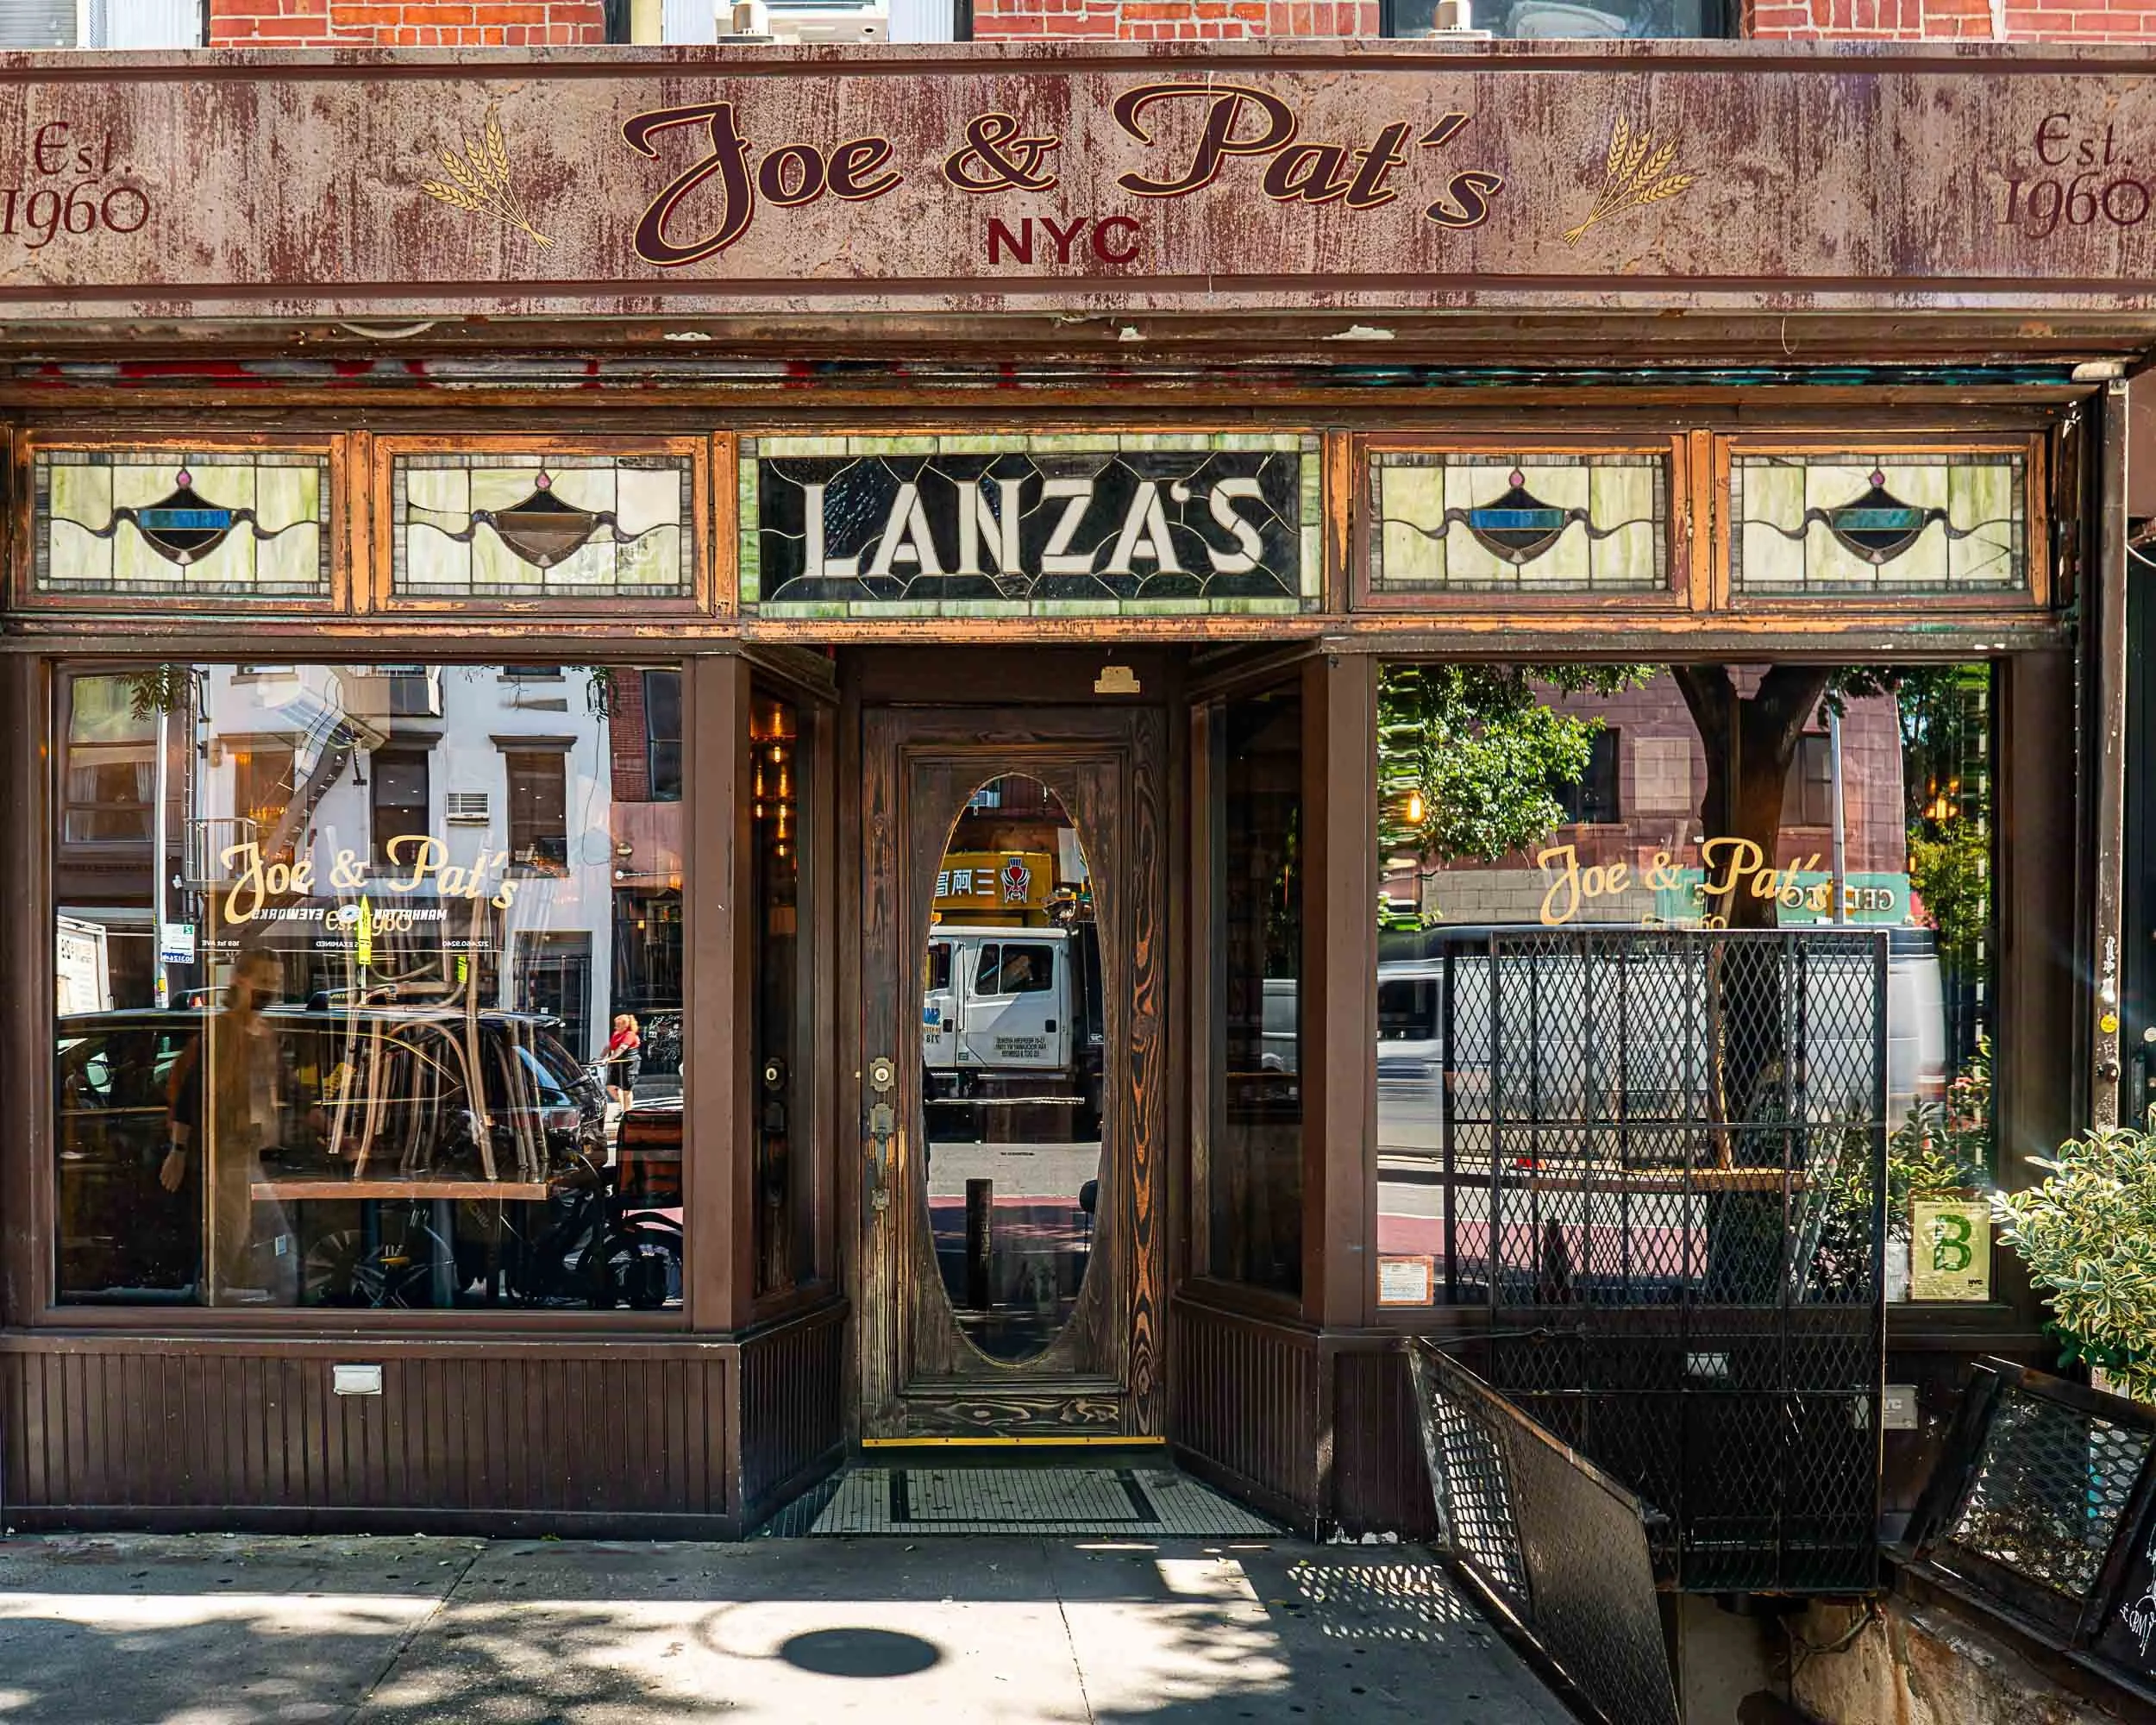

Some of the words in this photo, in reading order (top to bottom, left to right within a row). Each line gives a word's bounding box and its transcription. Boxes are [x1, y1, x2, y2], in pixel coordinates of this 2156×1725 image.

[34, 121, 133, 174] Est.
[621, 101, 903, 267] Joe
[943, 112, 1062, 194] &
[1111, 82, 1507, 230] Pat's
[2034, 113, 2134, 167] Est.
[0, 179, 150, 249] 1960
[2002, 169, 2151, 240] 1960
[987, 216, 1142, 265] NYC
[803, 475, 1263, 579] LANZA'S
[220, 841, 315, 925] Joe
[329, 849, 368, 889] &
[385, 835, 519, 909] Pat's
[1537, 844, 1631, 925] Joe
[1645, 851, 1684, 891] &
[1701, 837, 1829, 912] Pat's
[1934, 1214, 1972, 1271] B
